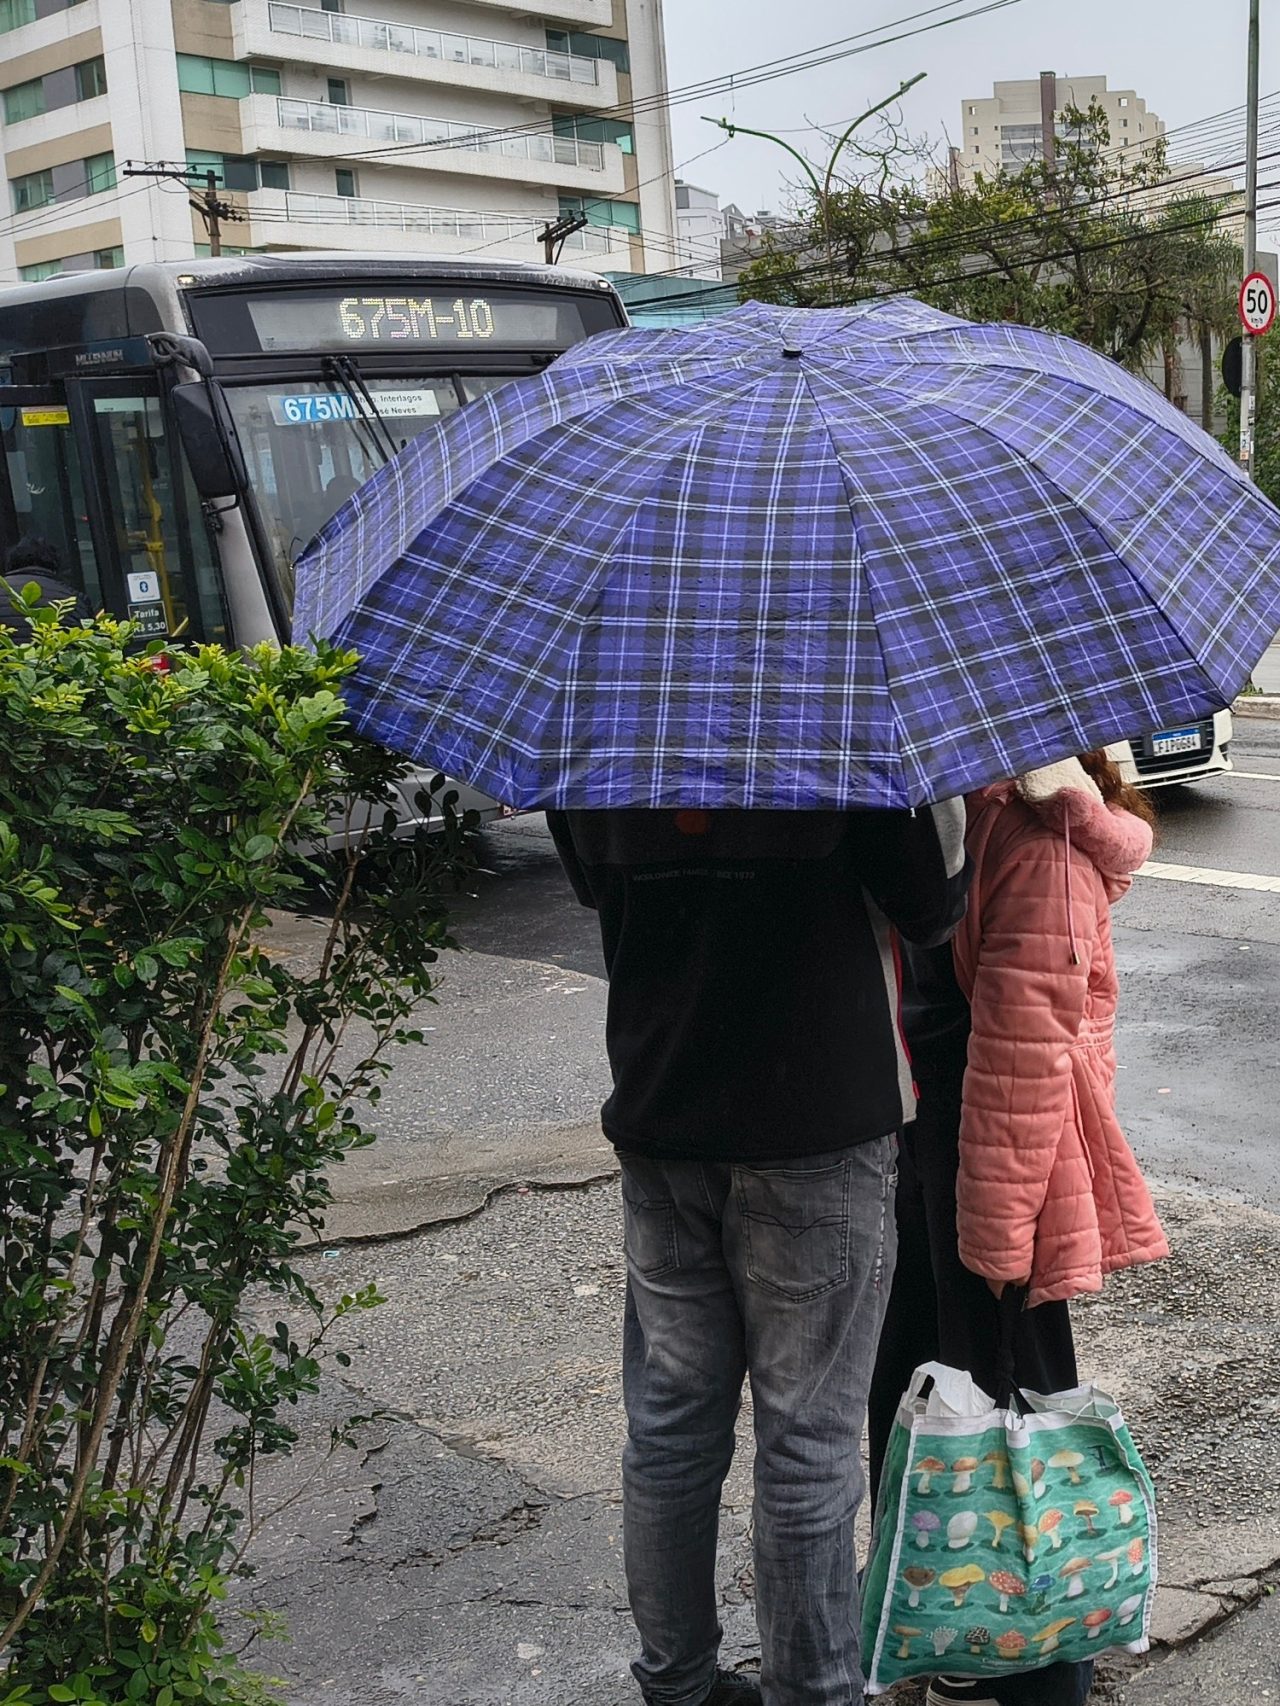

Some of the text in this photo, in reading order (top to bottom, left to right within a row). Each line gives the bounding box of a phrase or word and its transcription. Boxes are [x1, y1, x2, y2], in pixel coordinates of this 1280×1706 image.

[1247, 289, 1268, 314] 50
[339, 298, 496, 339] 675M-10
[380, 394, 423, 405] Interlagos
[391, 406, 417, 415] Neves
[134, 608, 160, 619] Tarifa
[147, 621, 166, 632] 5,30
